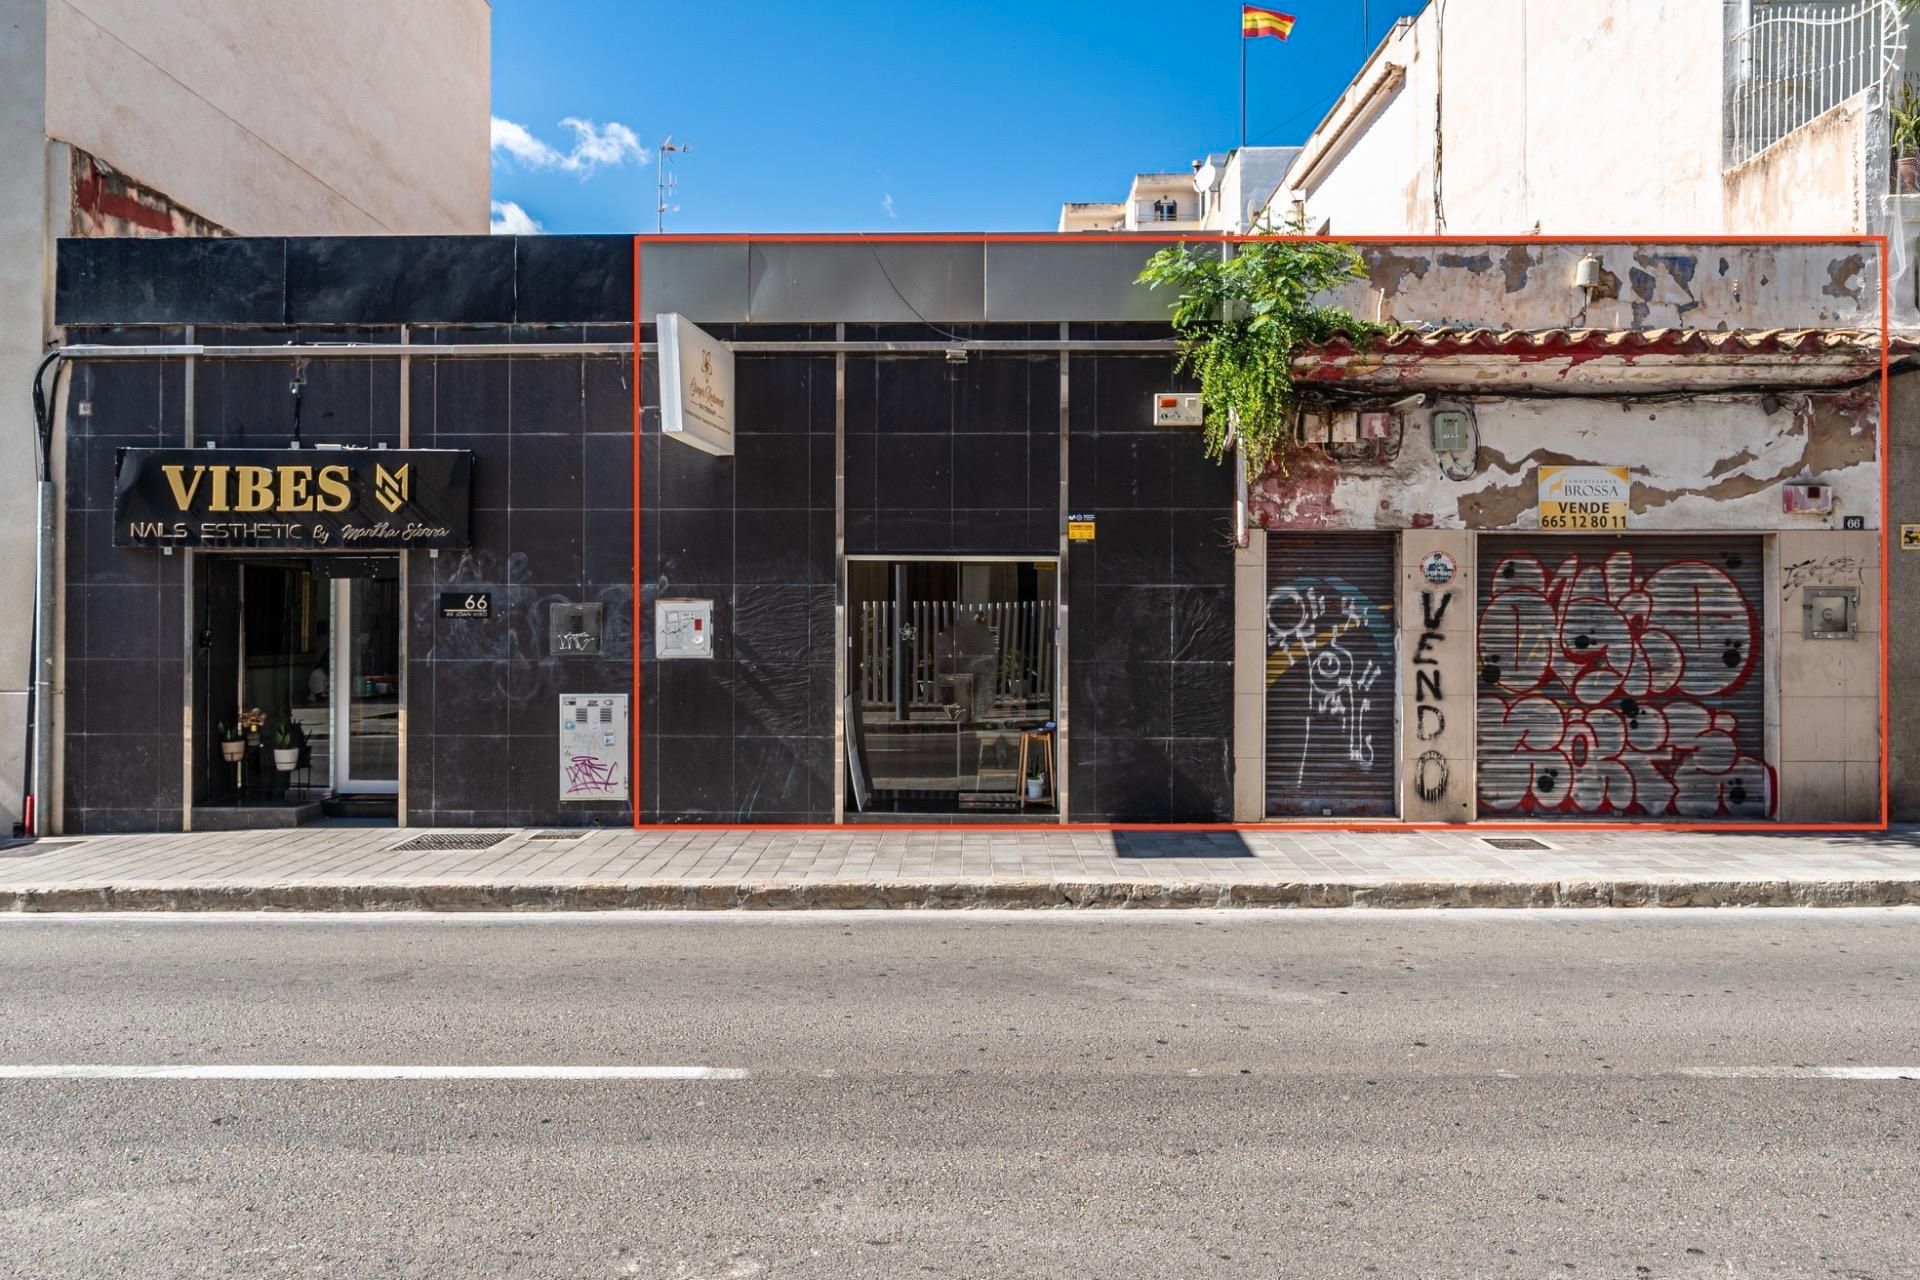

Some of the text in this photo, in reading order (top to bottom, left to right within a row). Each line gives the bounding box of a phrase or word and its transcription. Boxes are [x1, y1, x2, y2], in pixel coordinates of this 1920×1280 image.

[161, 465, 351, 513] VIBES
[1564, 485, 1619, 497] BROSSA
[1558, 502, 1610, 514] VENDE
[1541, 515, 1626, 528] 665 12 80 11
[1846, 519, 1861, 529] 66
[130, 522, 188, 538] NAILS
[200, 522, 303, 539] ESTHETIC
[312, 523, 330, 544] By
[341, 521, 400, 541] Martha
[465, 594, 488, 610] 66
[1412, 590, 1452, 803] VENDO
